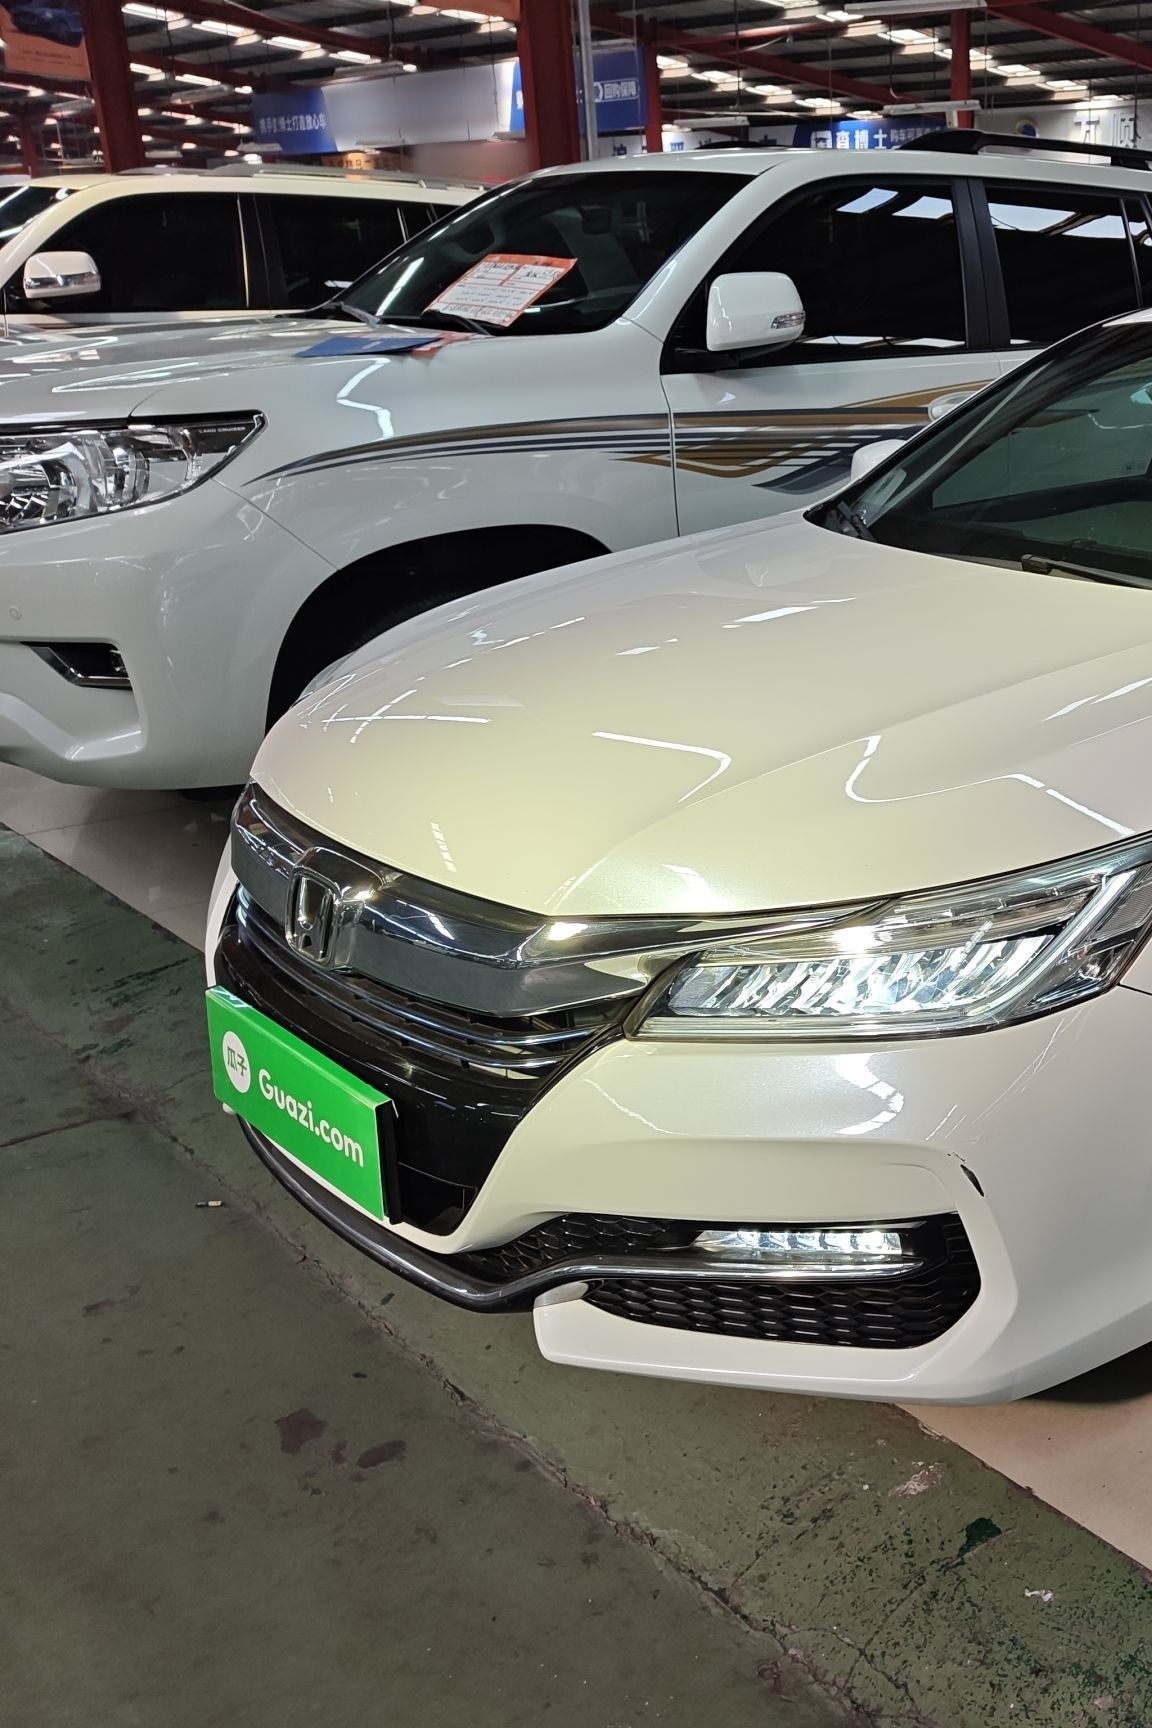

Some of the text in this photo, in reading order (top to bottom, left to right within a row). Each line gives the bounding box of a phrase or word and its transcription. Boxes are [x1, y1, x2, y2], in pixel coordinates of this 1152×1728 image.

[836, 129, 888, 150] 查博士
[226, 1045, 248, 1077] 瓜子
[258, 1068, 365, 1168] Guazi.com
